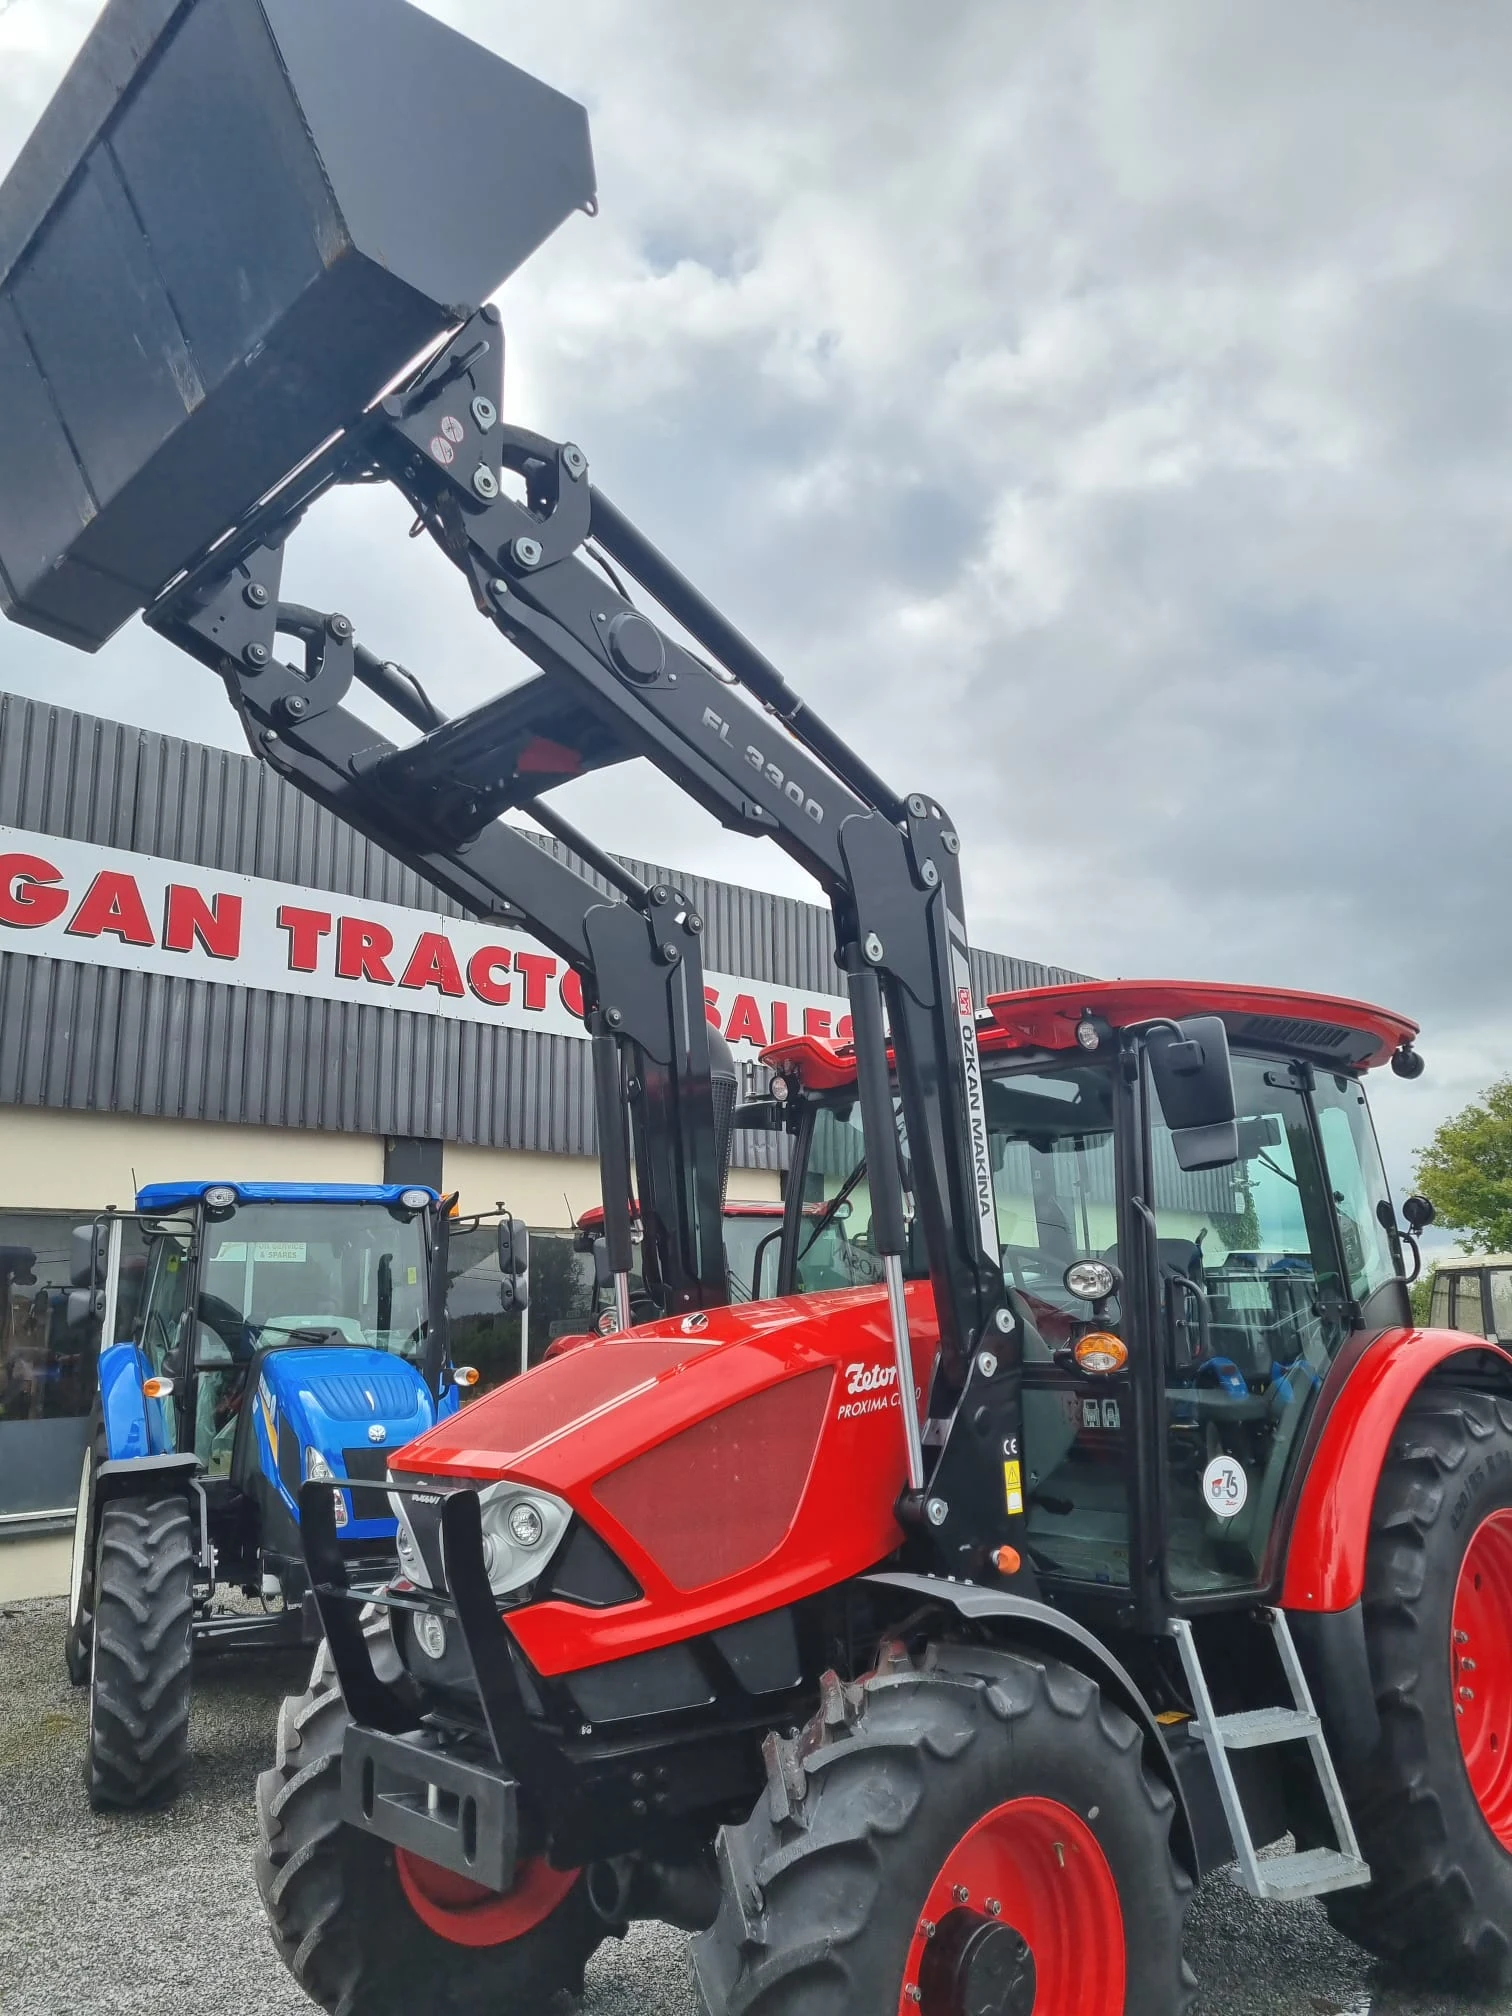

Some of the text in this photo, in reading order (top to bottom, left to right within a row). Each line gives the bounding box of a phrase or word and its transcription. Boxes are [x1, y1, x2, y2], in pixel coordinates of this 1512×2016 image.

[702, 706, 823, 825] FL 3300
[0, 852, 242, 961] GAN
[962, 1025, 981, 1111] ÖZKAN
[268, 1251, 297, 1259] SPARES
[838, 1396, 888, 1420] PROXIMA
[845, 1363, 897, 1395] Zetor
